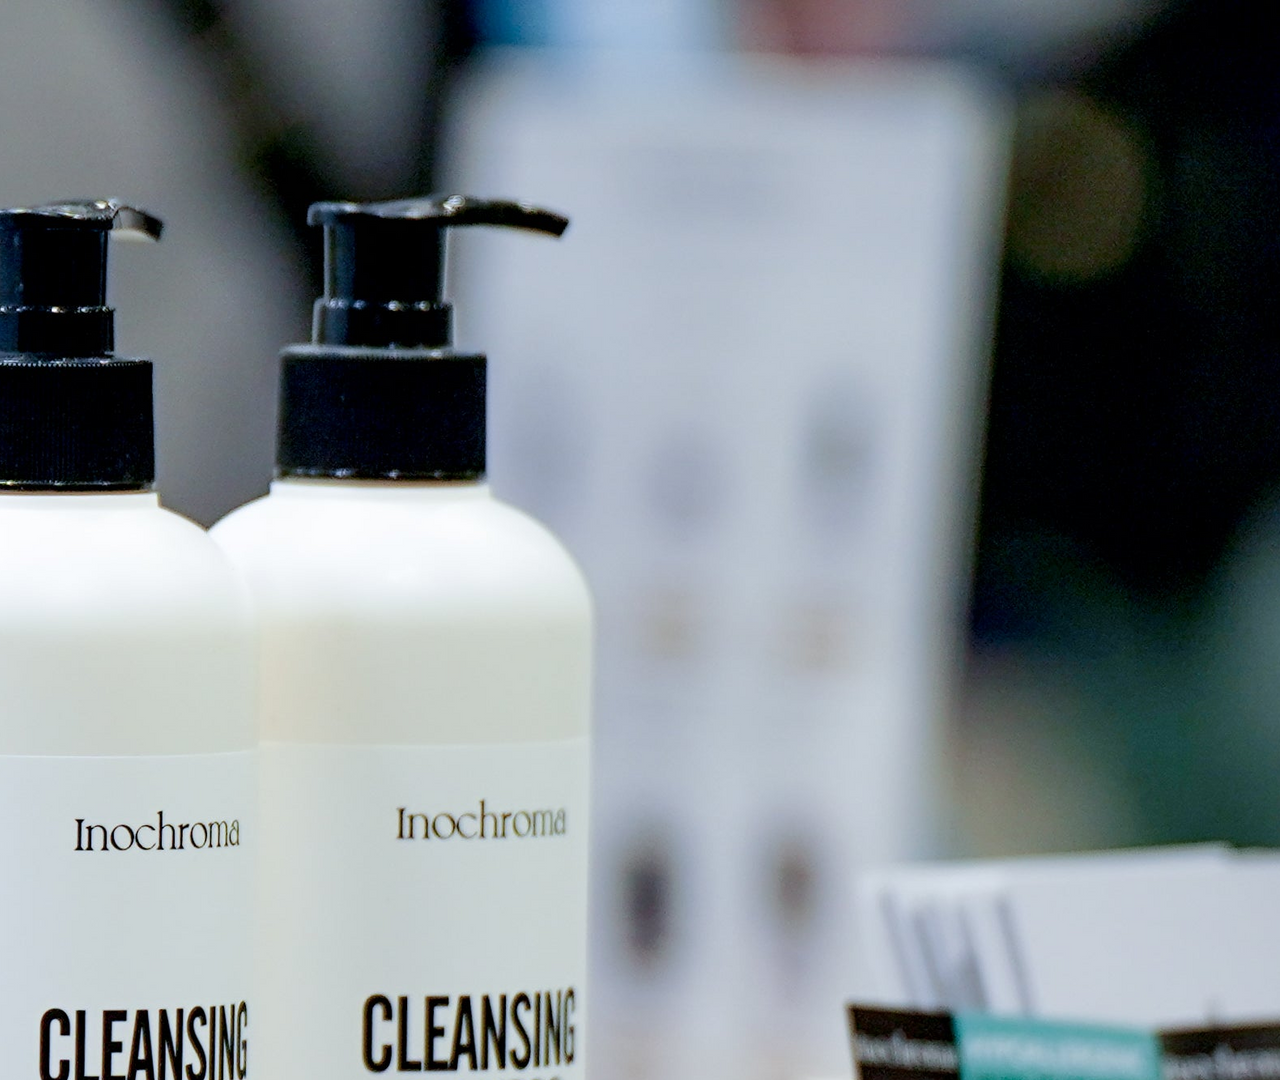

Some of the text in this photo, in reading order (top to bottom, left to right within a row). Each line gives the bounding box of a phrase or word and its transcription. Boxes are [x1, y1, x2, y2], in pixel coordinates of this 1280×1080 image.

[74, 811, 240, 852] Inochroma
[396, 801, 566, 841] Inochroma
[363, 986, 576, 1073] CLEANSING
